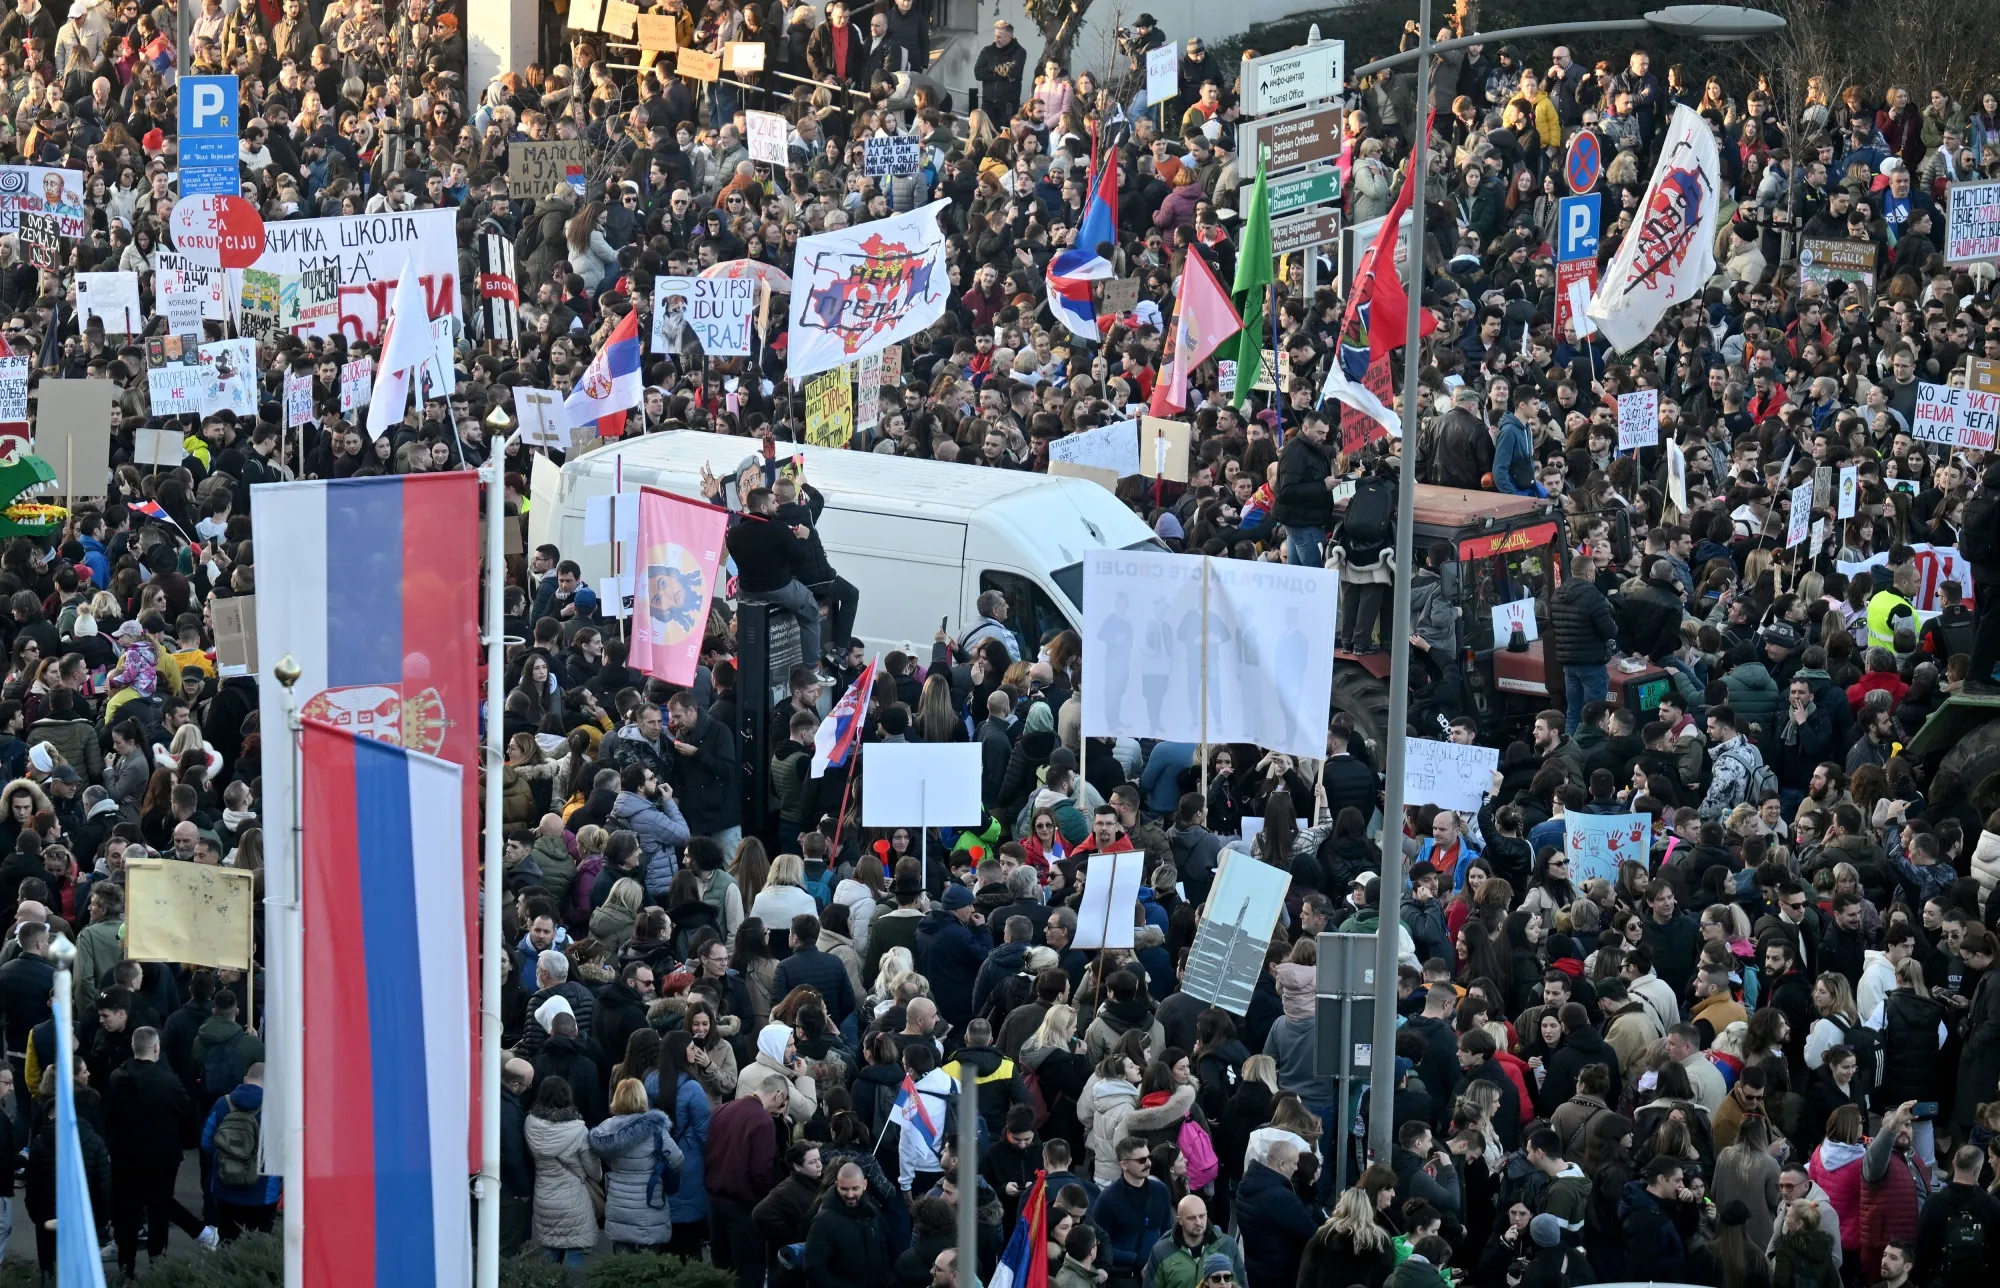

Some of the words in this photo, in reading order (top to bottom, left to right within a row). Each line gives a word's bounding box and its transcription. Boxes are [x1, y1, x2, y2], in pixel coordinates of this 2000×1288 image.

[192, 84, 224, 128] P
[1269, 92, 1288, 106] Tourist
[1288, 90, 1304, 101] Office
[1274, 122, 1298, 136] Саборна
[1298, 118, 1315, 133] црква
[1274, 140, 1294, 153] Serbian
[1294, 133, 1320, 148] Orthodox
[1274, 150, 1299, 165] Cathedral
[1274, 182, 1300, 198] Дунавски
[1300, 180, 1313, 192] парк
[202, 198, 229, 212] LEK
[1273, 196, 1294, 211] Danube
[1294, 192, 1306, 204] Park
[208, 218, 228, 230] ZA
[340, 218, 418, 247] ШКОЛА
[1568, 204, 1590, 252] P
[178, 235, 257, 250] KORUPCIJU
[1273, 236, 1300, 252] Vojvodina
[1300, 230, 1321, 245] Museum
[693, 300, 724, 320] IDU
[732, 300, 742, 318] U
[172, 320, 200, 329] ДРЖАВУ
[172, 388, 184, 398] НЕ
[1918, 385, 1935, 402] КО
[1941, 389, 1960, 406] ЈЕ
[1966, 392, 2000, 411] ЧИСТ
[1916, 404, 1954, 424] НЕМА
[1964, 410, 1994, 430] ЧЕГА
[1051, 436, 1080, 449] STUDENTI
[1958, 428, 1995, 448] ПЛАШИ
